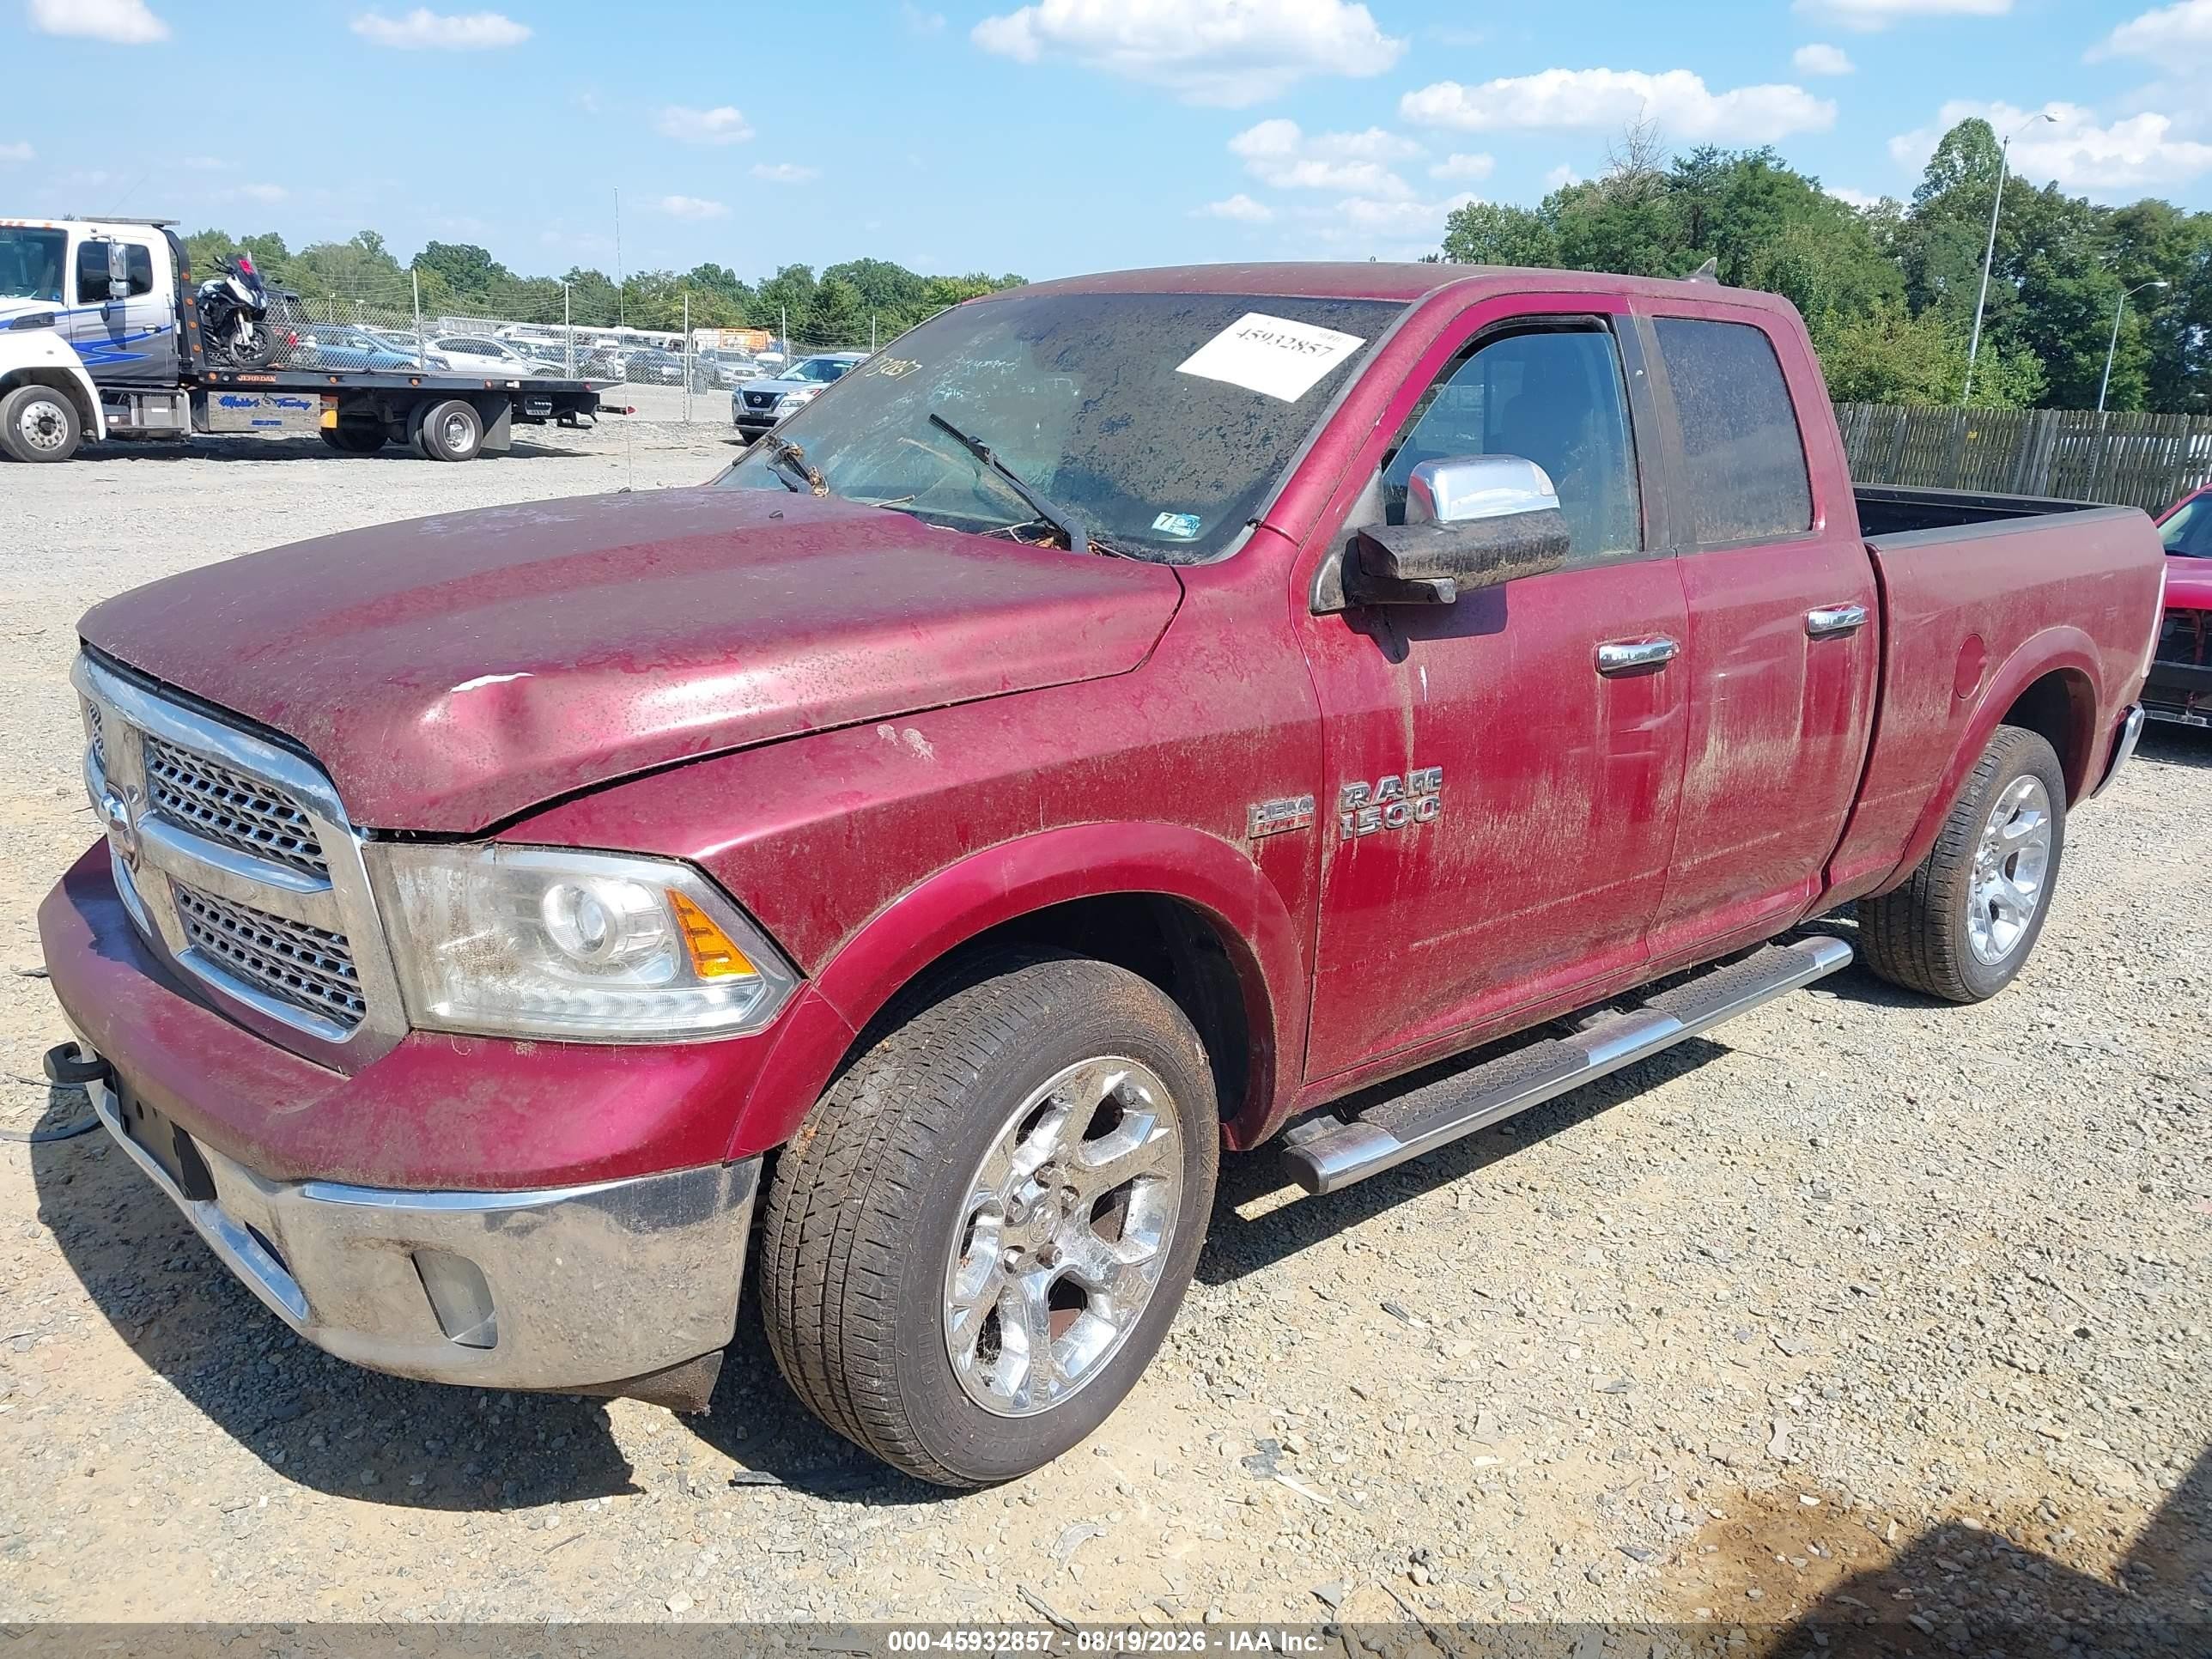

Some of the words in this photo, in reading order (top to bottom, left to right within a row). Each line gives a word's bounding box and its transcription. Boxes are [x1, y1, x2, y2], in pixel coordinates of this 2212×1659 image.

[1237, 328, 1335, 357] 45932857
[1160, 514, 1173, 526] 7
[1340, 765, 1443, 812] RAM
[1249, 795, 1315, 824] HEMI
[1340, 795, 1442, 842] 1500
